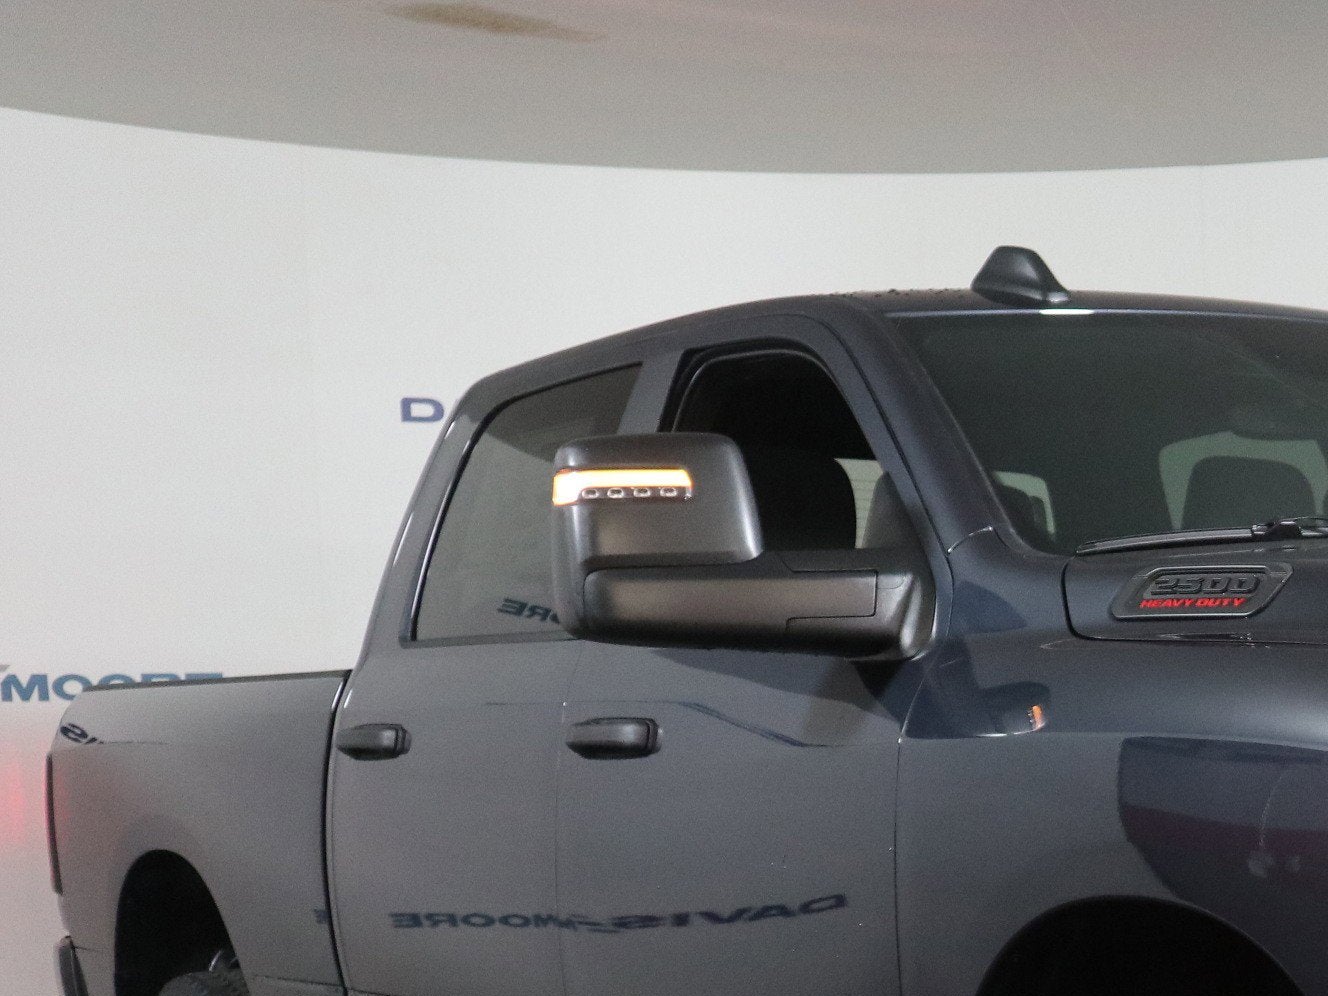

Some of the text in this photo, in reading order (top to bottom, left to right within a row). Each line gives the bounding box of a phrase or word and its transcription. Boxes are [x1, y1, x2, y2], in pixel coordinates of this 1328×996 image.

[1150, 575, 1261, 596] 2500
[1139, 597, 1248, 610] HEAVY DUTY
